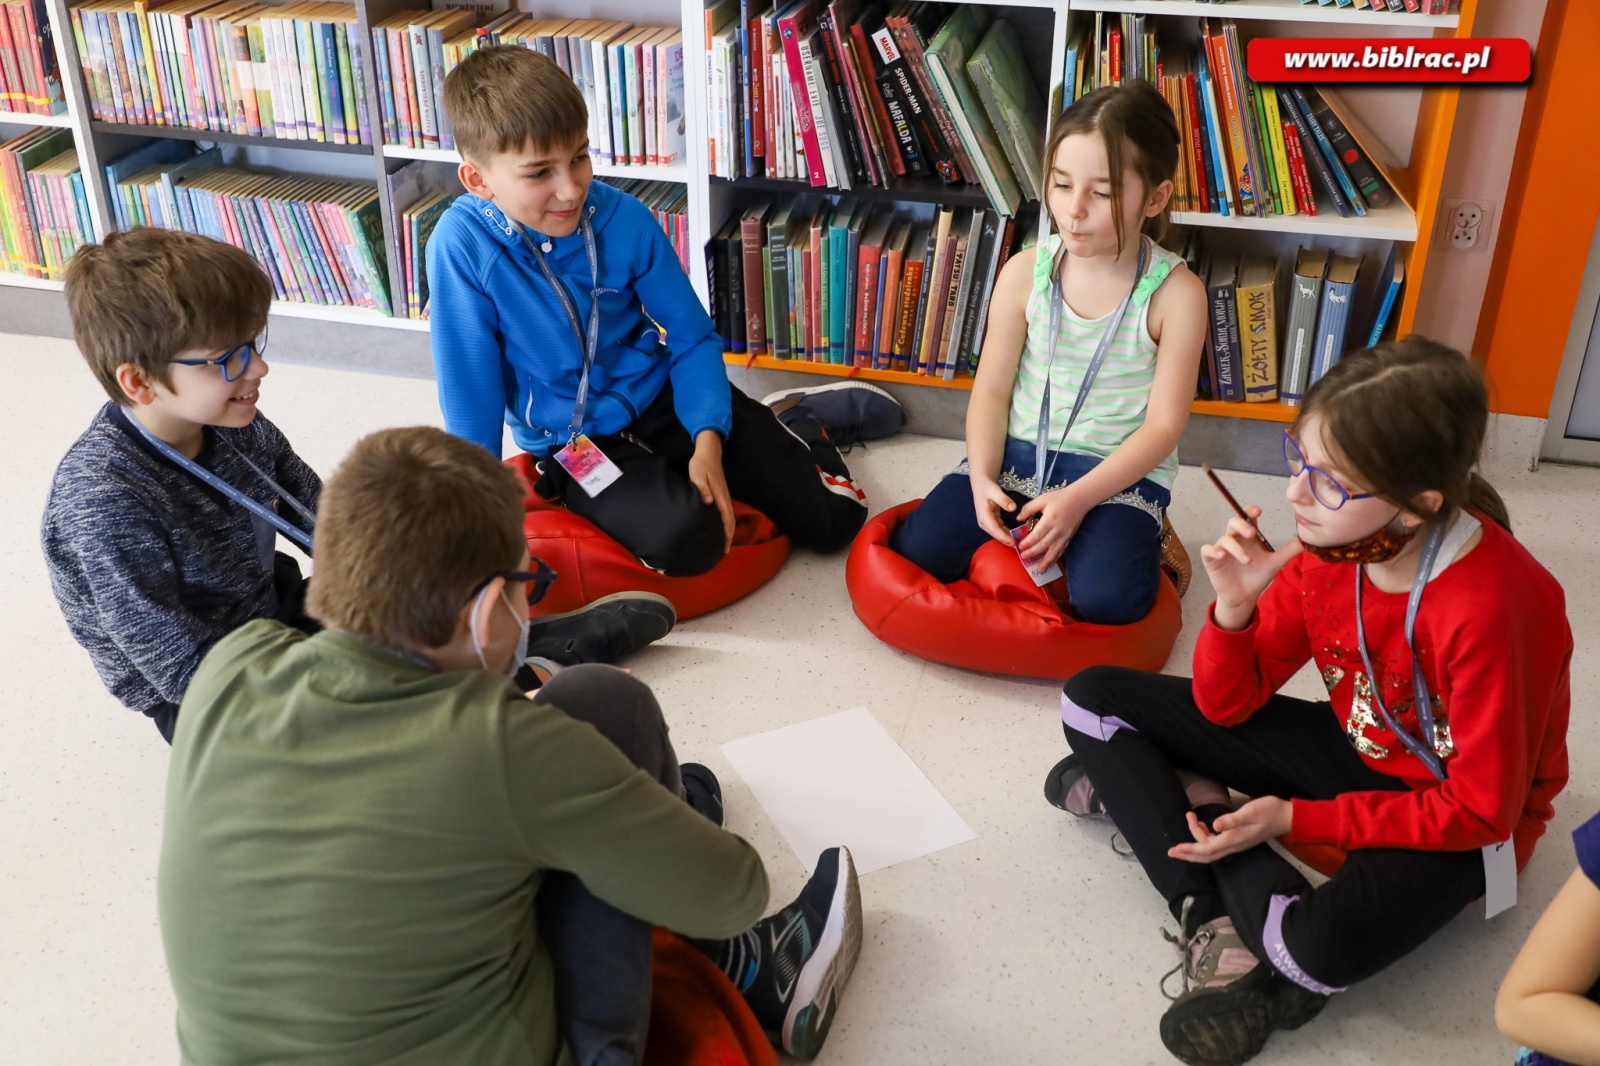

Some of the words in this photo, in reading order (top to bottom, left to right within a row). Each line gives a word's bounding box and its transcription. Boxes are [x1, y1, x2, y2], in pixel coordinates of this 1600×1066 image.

[879, 37, 896, 61] MARVEL
[801, 46, 816, 89] USERNAME:
[810, 90, 820, 107] EVIE
[894, 67, 922, 115] SPIDER-MAN
[814, 116, 826, 129] JOE
[888, 101, 912, 144] MAFALDA
[1306, 113, 1318, 131] FAIRY
[818, 131, 830, 150] SUGG
[953, 252, 964, 280] TATSU
[899, 309, 908, 344] Cudowna
[904, 266, 914, 308] studzienka
[1249, 292, 1267, 334] SMOK
[1215, 326, 1229, 352] SORIA
[1218, 352, 1232, 384] ZAMEK
[1246, 339, 1270, 383] ŻÓŁTY
